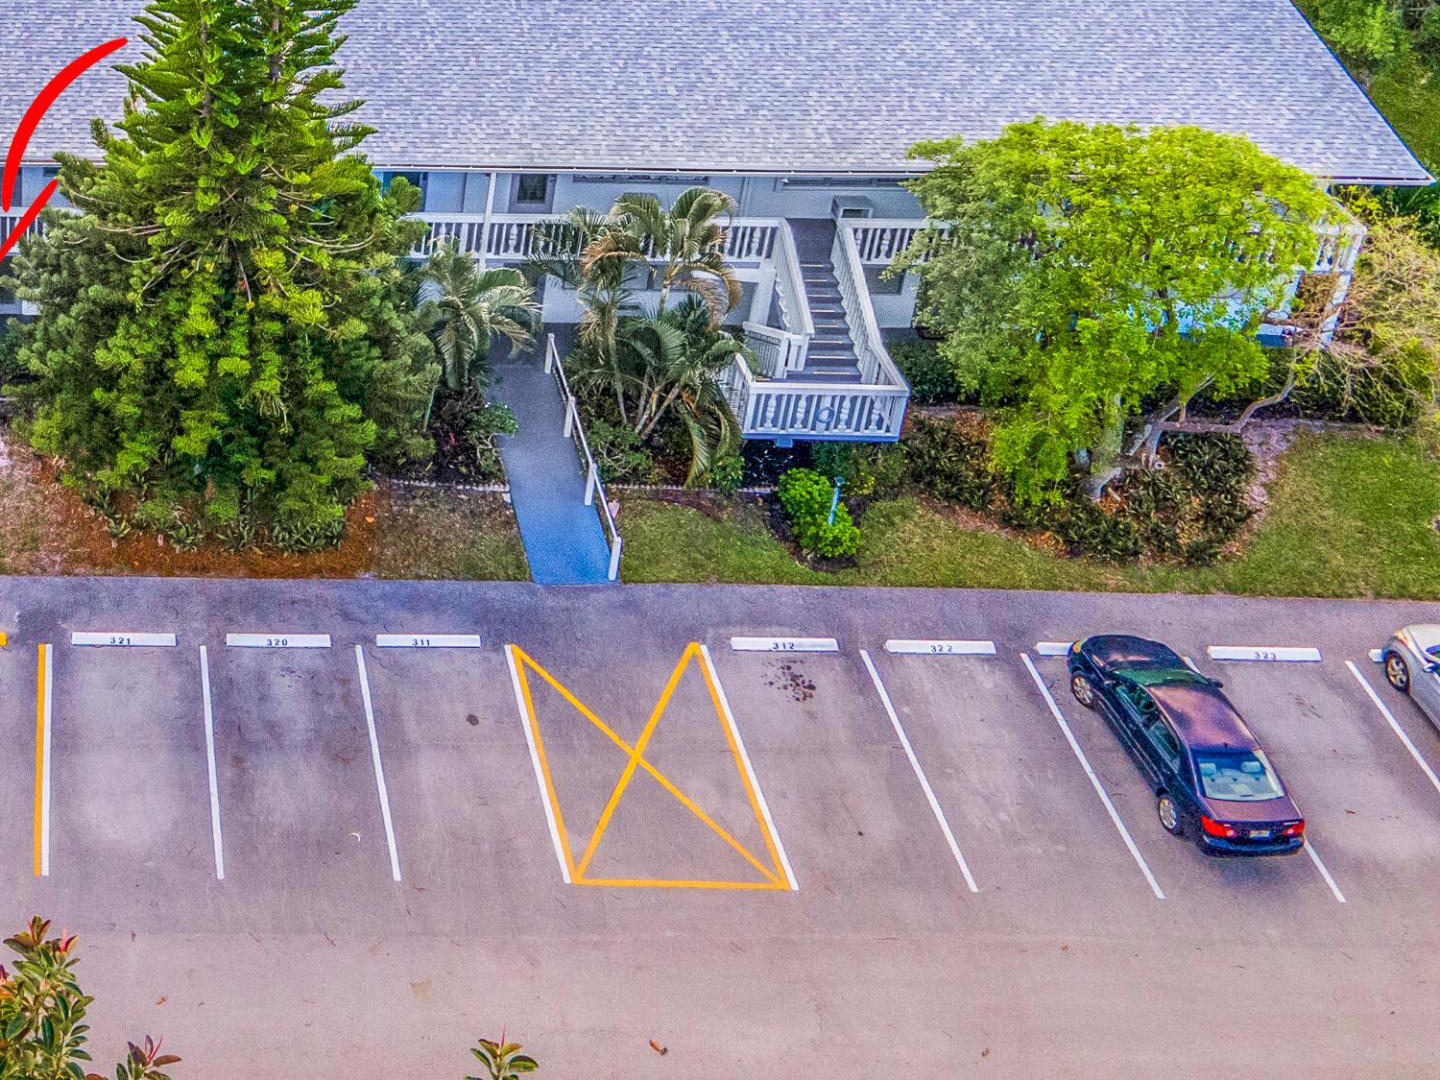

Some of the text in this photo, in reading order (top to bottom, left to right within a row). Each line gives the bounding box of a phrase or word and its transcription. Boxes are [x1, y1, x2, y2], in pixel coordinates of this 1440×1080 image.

[110, 636, 131, 645] 321
[266, 638, 288, 647] 320
[412, 638, 431, 647] 311
[772, 641, 795, 650] 312
[930, 644, 953, 653] 322
[1254, 651, 1277, 661] 323
